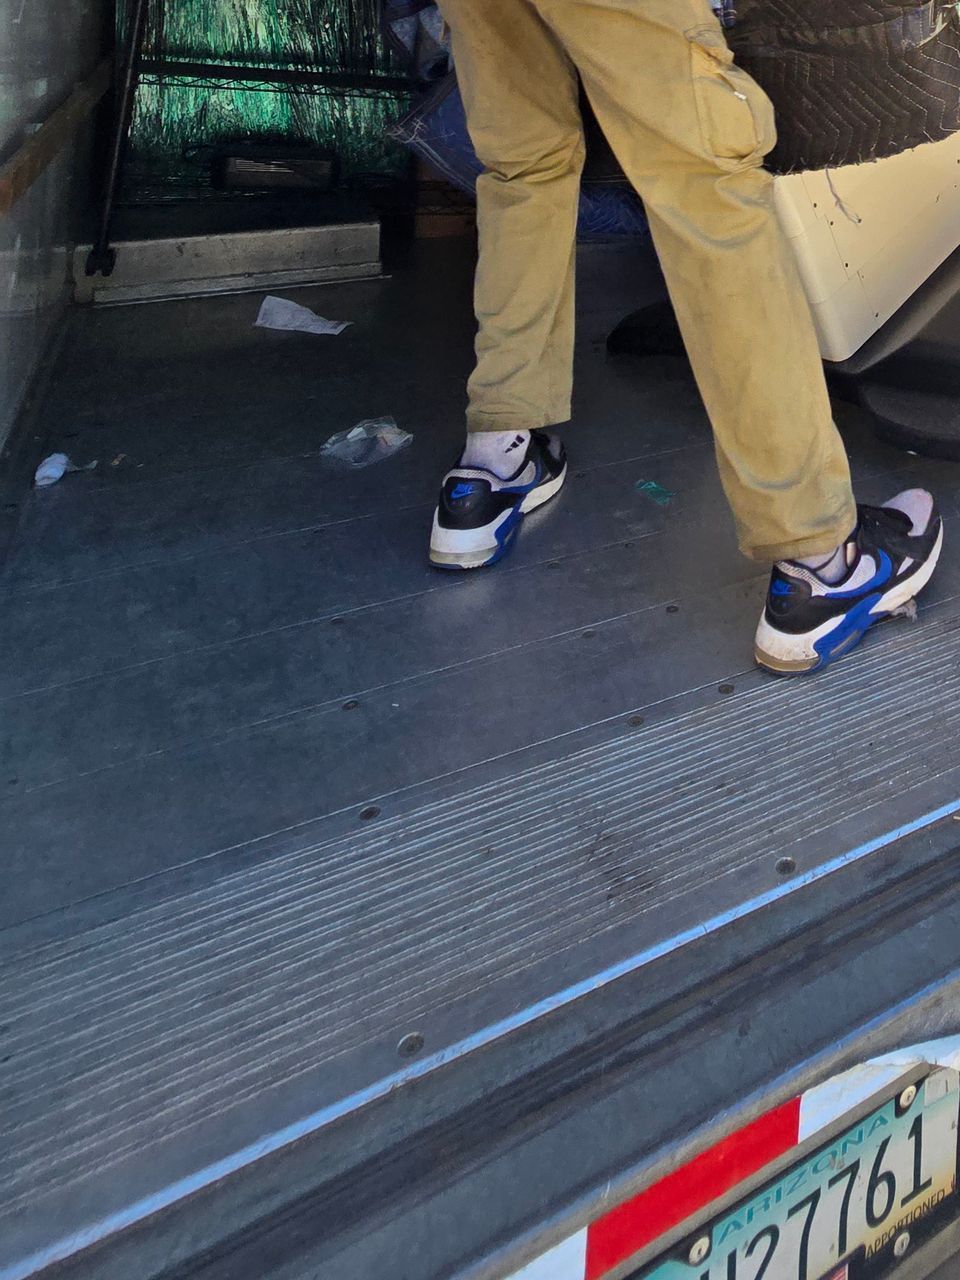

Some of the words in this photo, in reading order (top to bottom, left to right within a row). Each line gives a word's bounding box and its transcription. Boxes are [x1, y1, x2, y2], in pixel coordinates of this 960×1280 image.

[700, 1111, 933, 1280] 27761
[717, 1114, 889, 1247] ARIZONA
[867, 1188, 946, 1258] APPORTIONED
